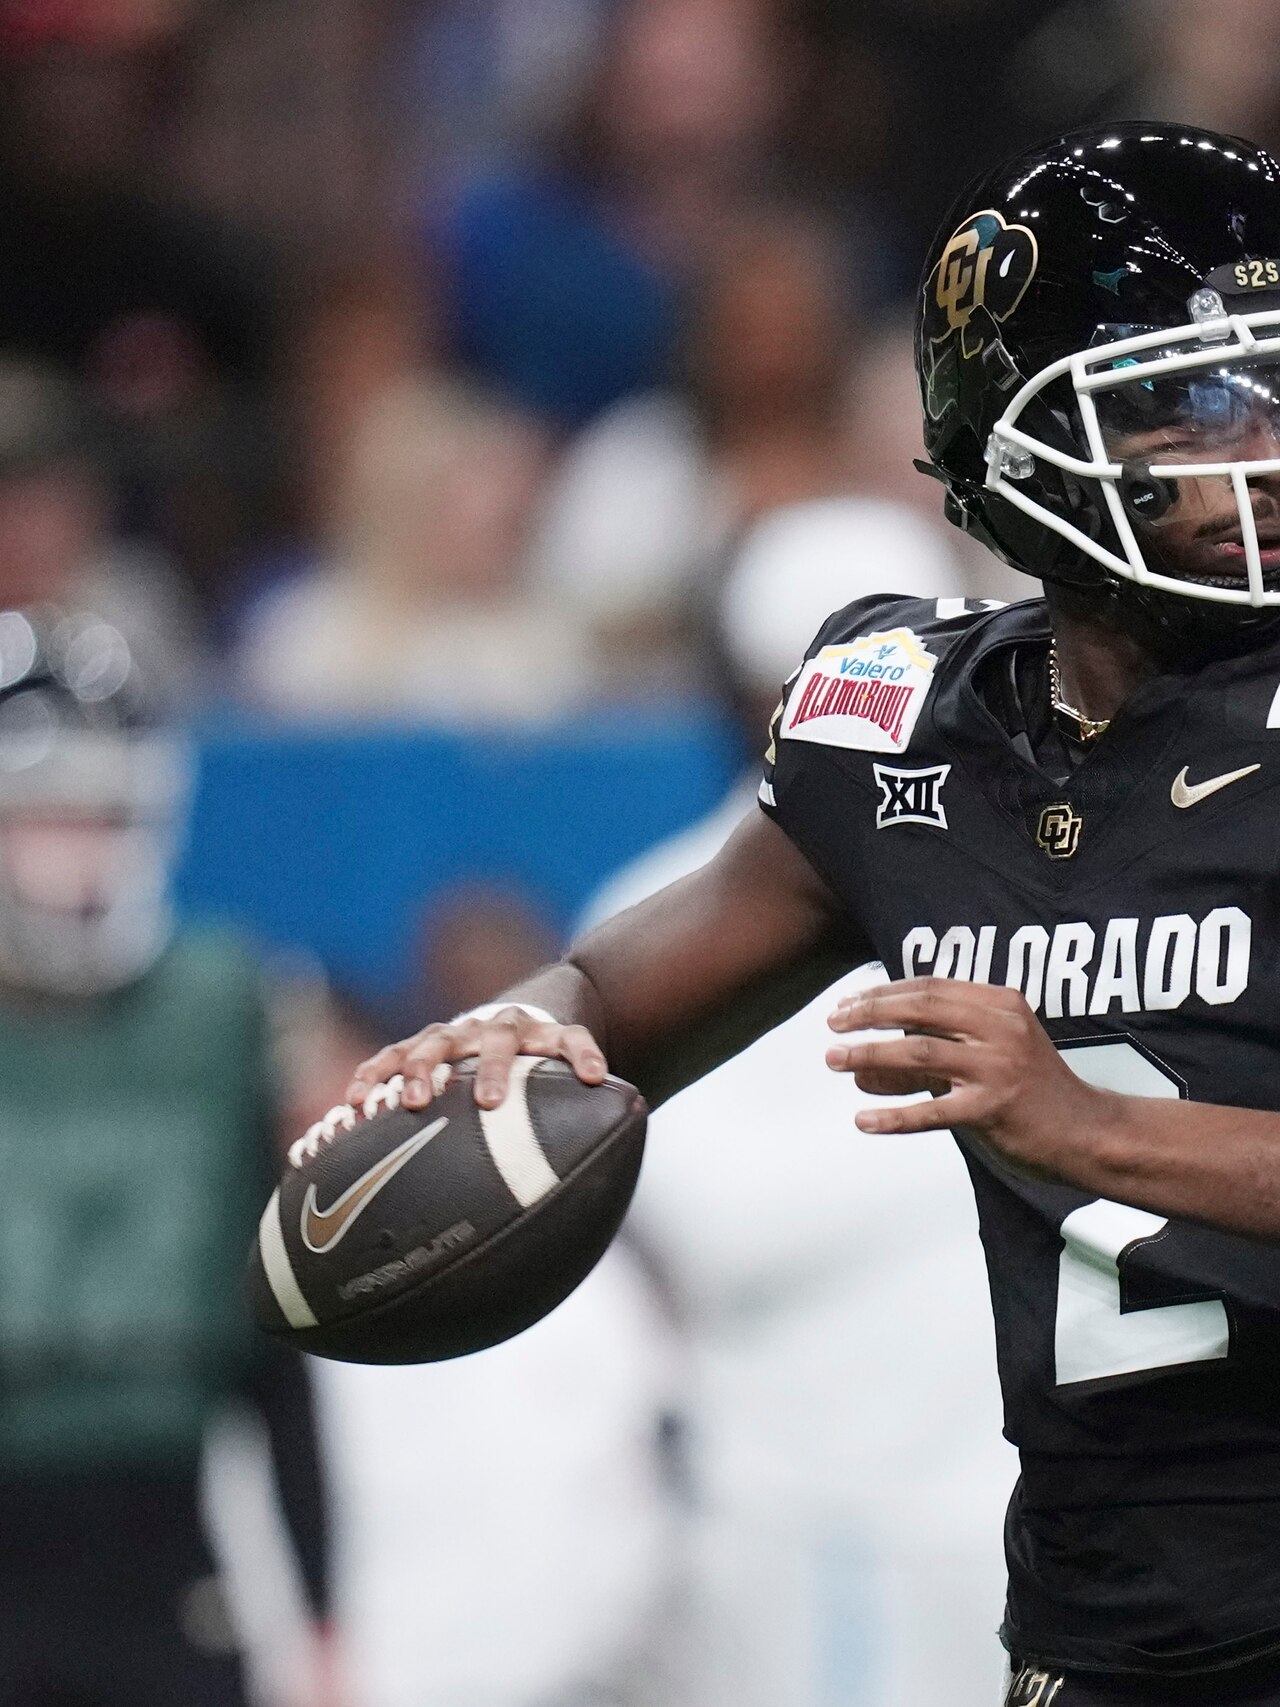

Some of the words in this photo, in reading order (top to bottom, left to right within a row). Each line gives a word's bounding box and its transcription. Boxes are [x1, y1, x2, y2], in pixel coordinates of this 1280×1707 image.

[1234, 260, 1279, 287] S2S
[840, 656, 905, 682] Valero
[877, 769, 945, 824] XII
[1036, 804, 1082, 859] CU
